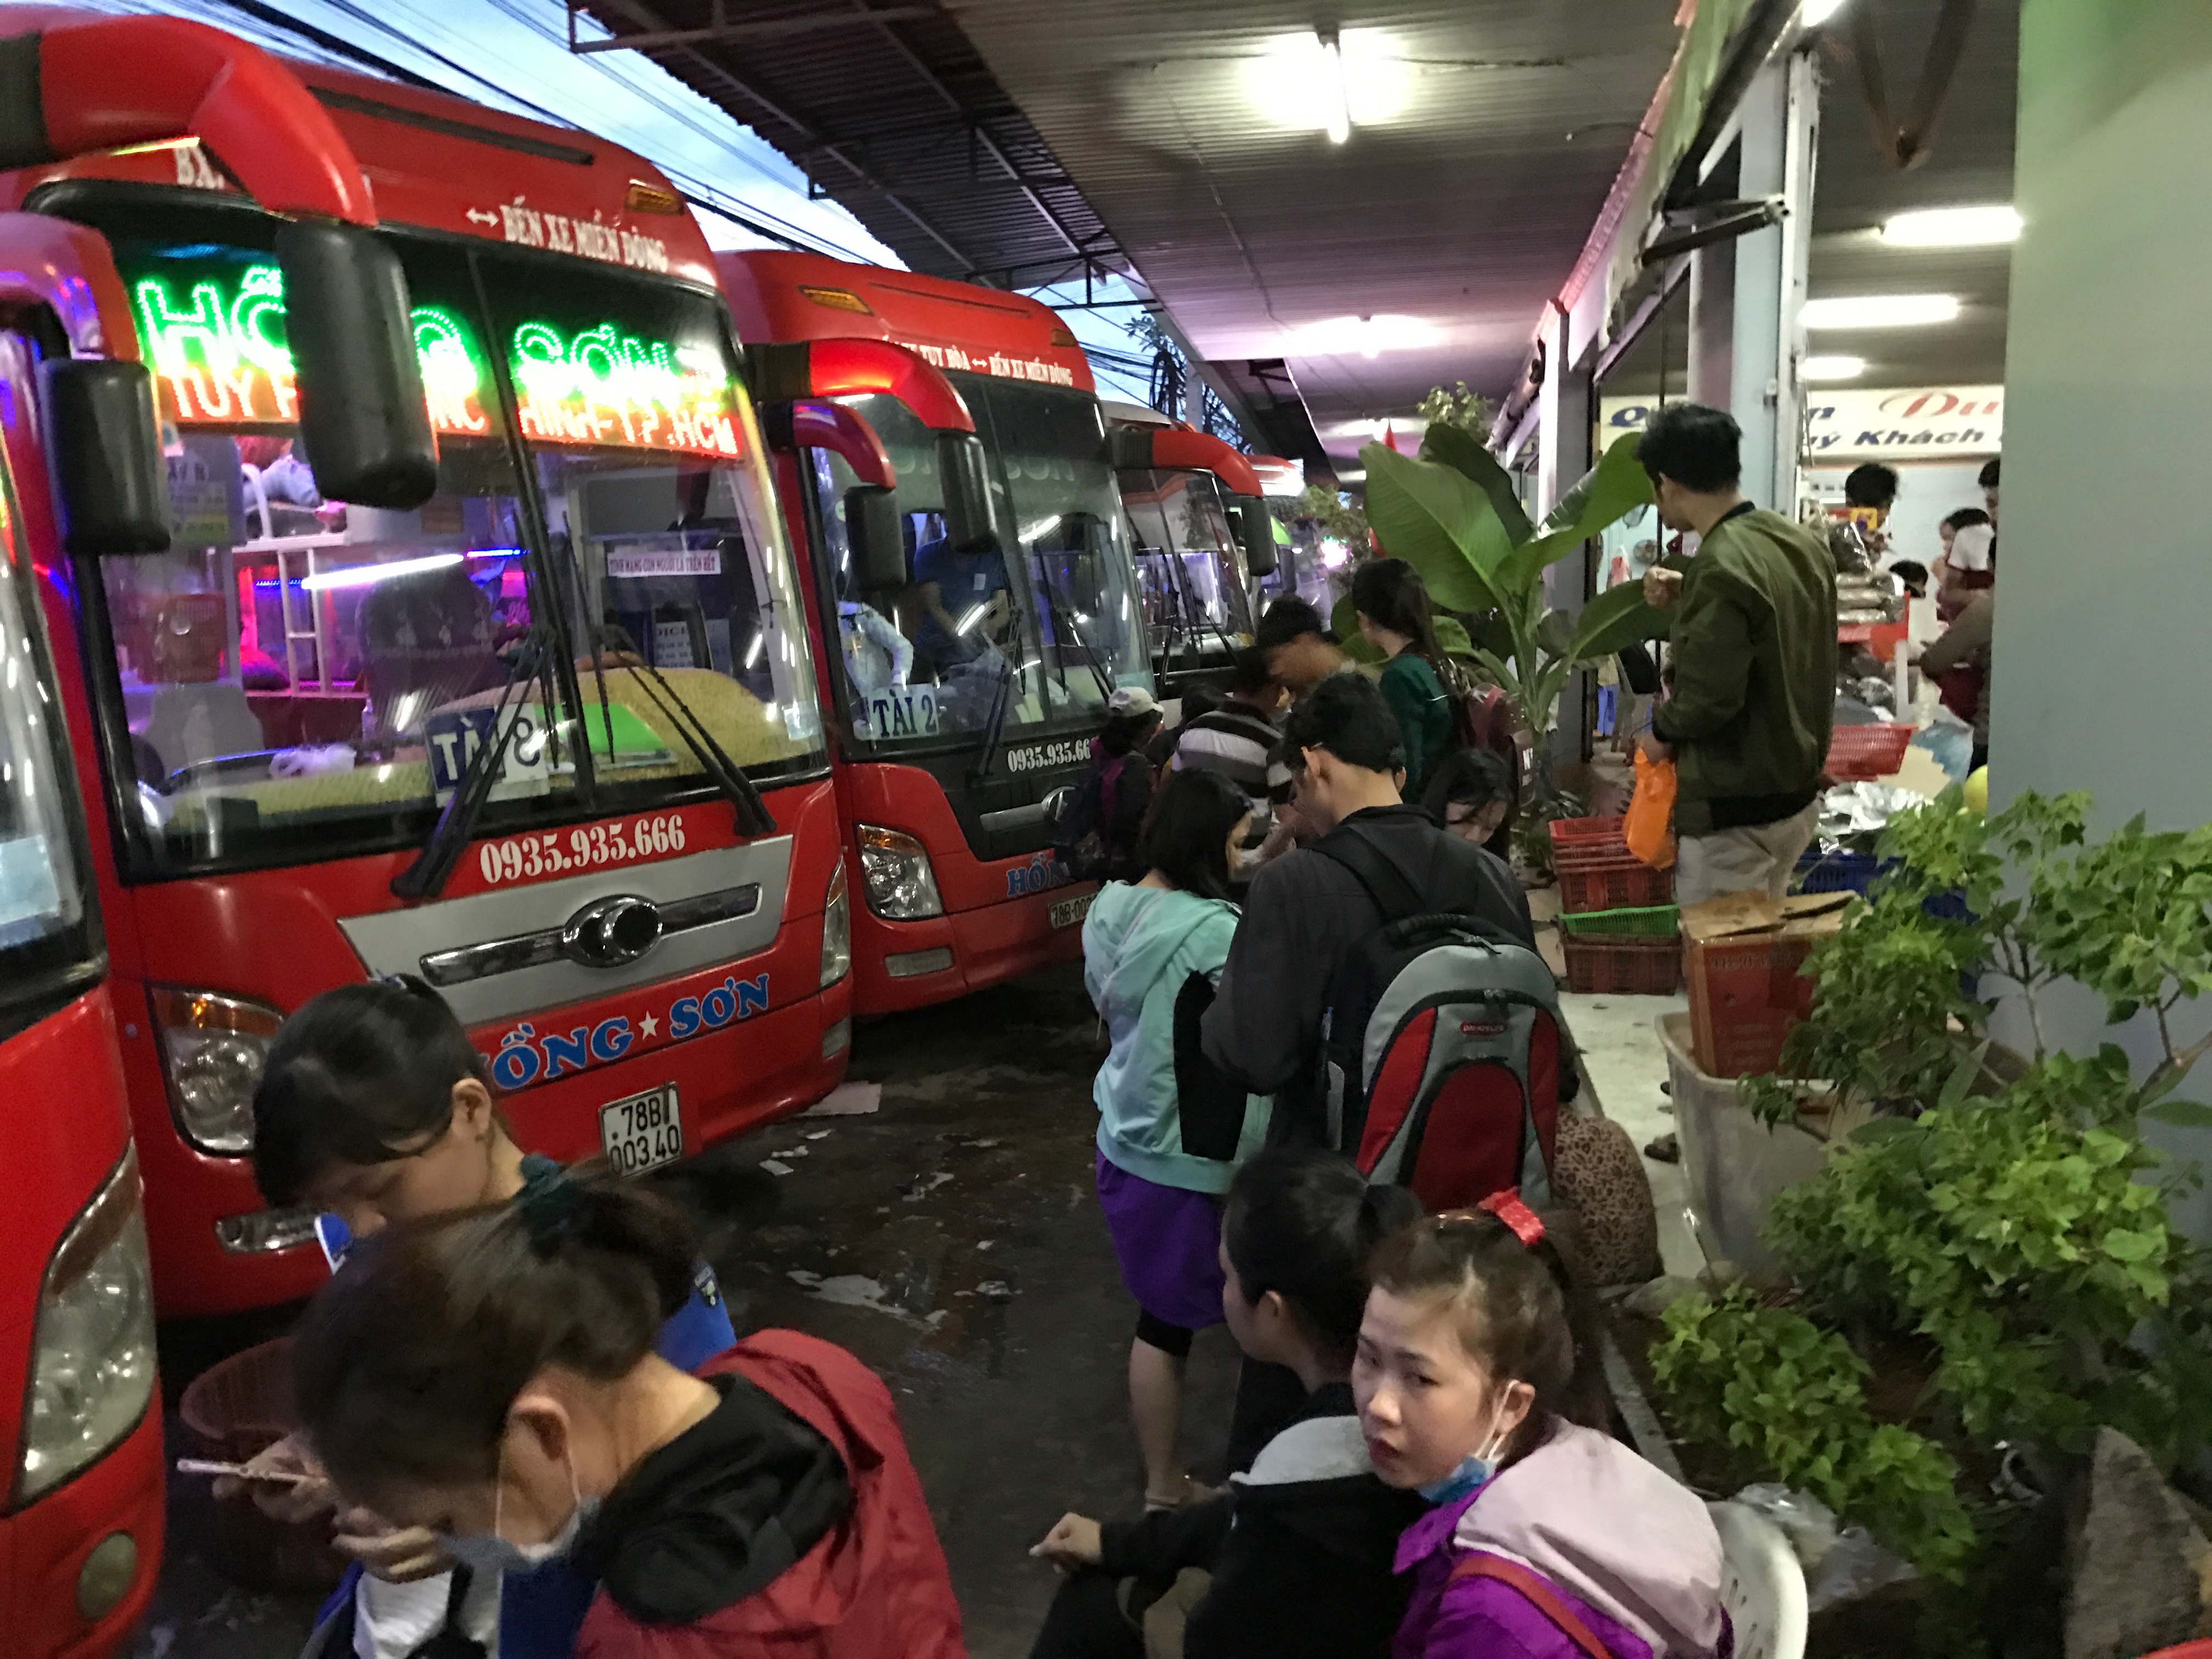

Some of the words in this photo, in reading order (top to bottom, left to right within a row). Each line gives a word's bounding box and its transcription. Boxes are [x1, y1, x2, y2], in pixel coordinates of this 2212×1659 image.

[543, 212, 574, 253] XE
[1010, 359, 1025, 379] XE
[1853, 428, 1985, 446] Khách
[873, 689, 918, 738] TÀI
[921, 694, 937, 733] 2
[479, 814, 686, 884] 0935.935.666
[492, 1015, 634, 1090] ỒNG
[669, 973, 769, 1039] SƠN
[620, 1097, 662, 1137] 78B
[610, 1125, 680, 1175] 003.40
